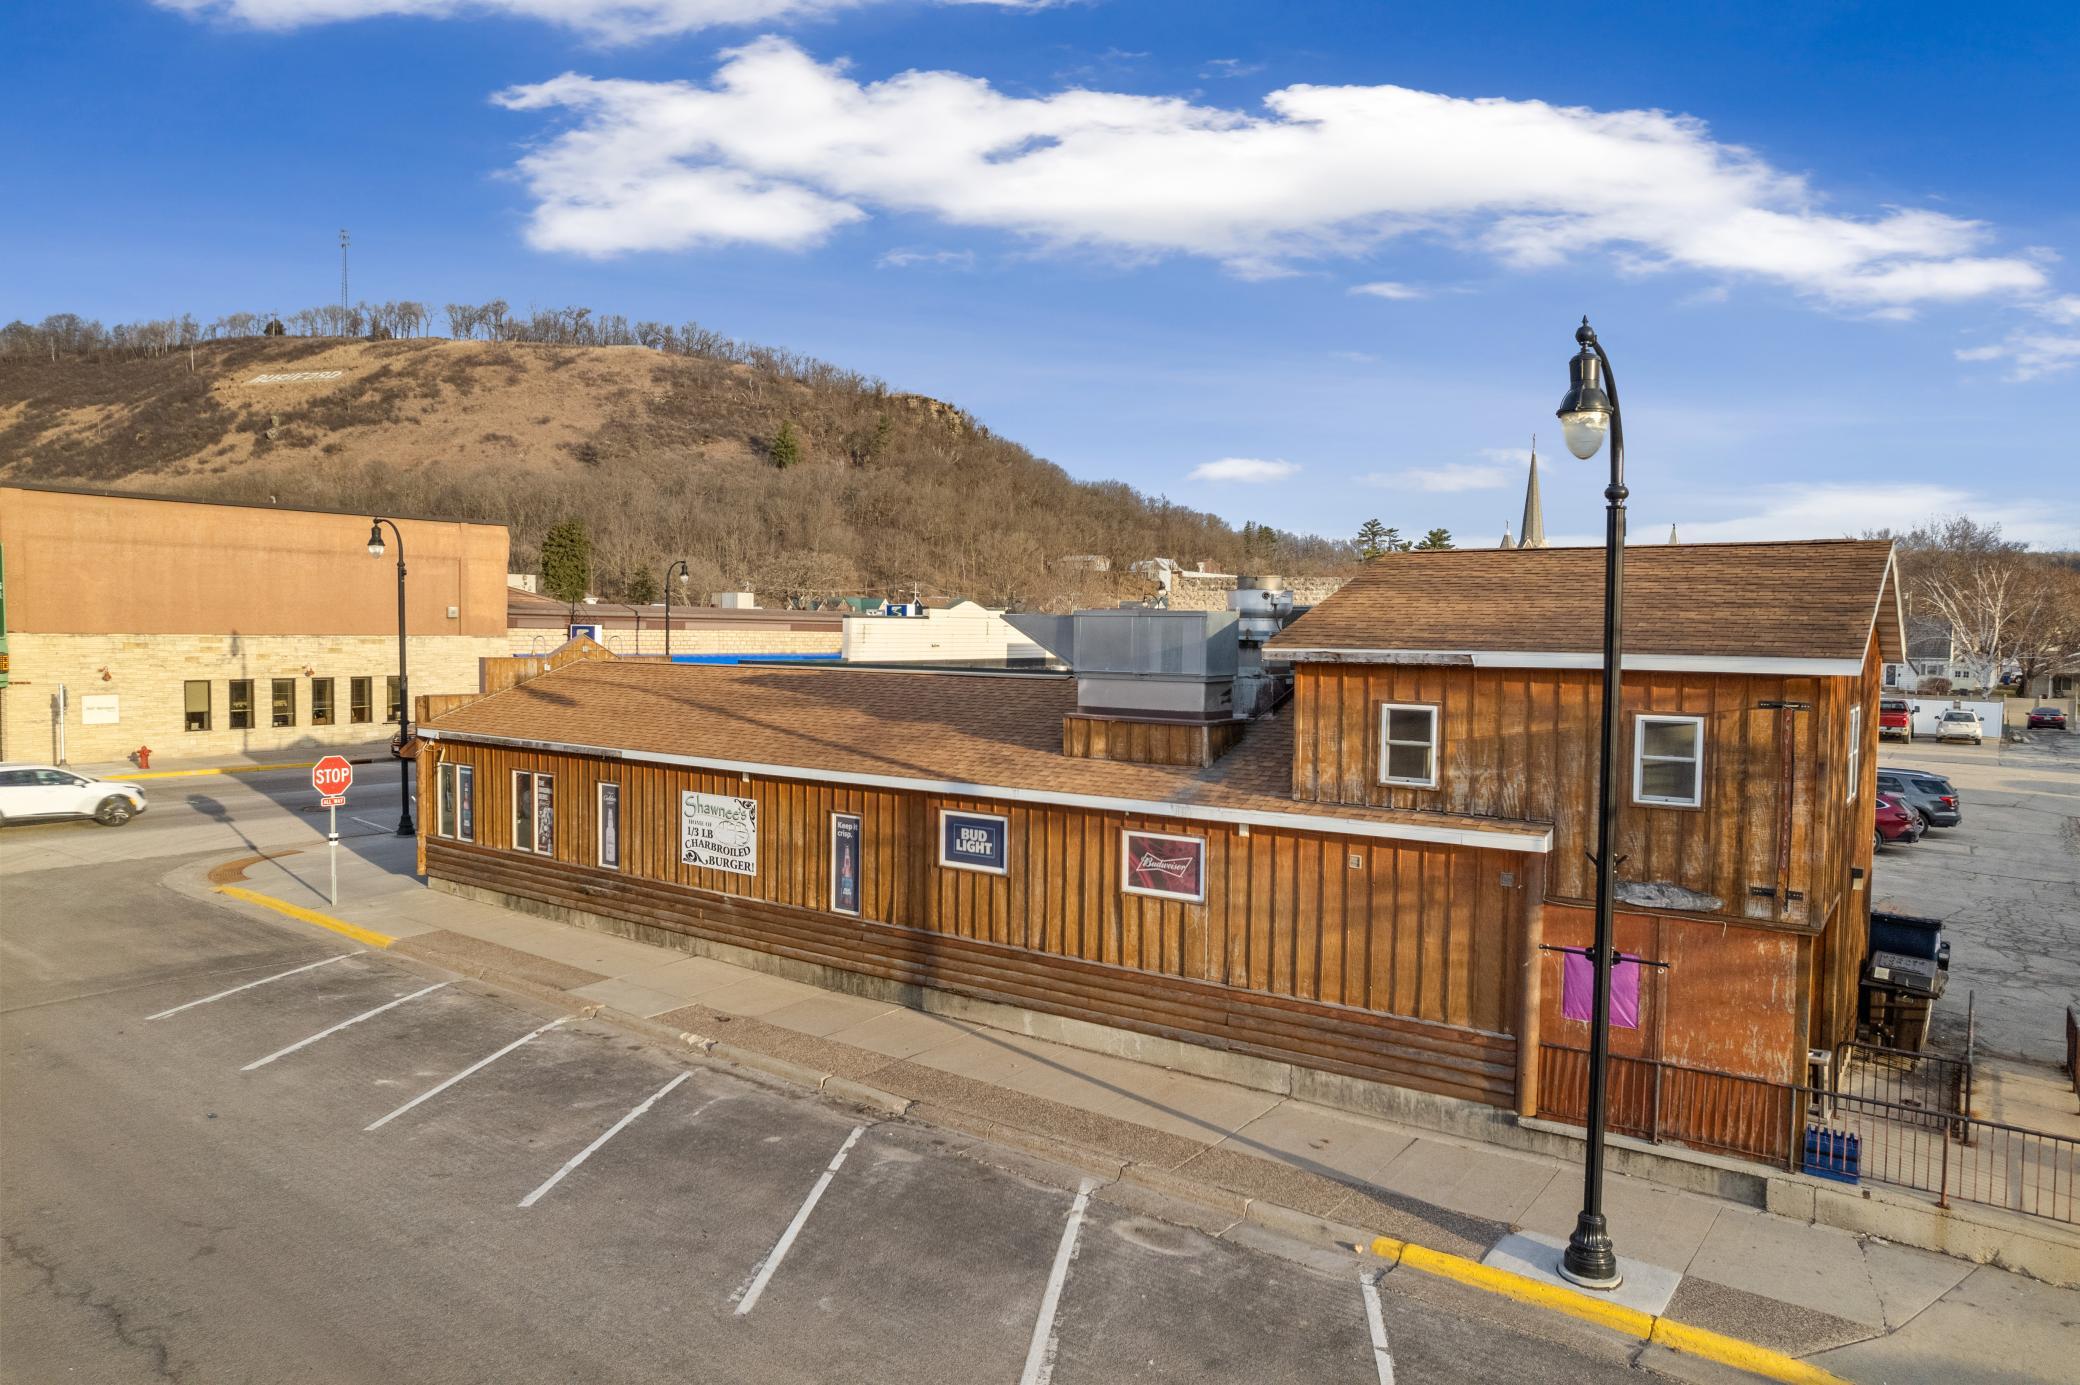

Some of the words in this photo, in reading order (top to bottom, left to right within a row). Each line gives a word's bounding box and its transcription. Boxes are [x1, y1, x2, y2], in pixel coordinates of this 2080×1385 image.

[316, 768, 350, 784] STOP
[684, 794, 747, 821] Shawnee's
[688, 818, 703, 826] HOME
[837, 821, 853, 832] Keep
[853, 823, 859, 831] it
[687, 826, 699, 837] 1/3
[702, 828, 714, 839] LB
[837, 830, 853, 839] crisp.
[961, 827, 988, 842] BUD
[684, 838, 751, 857] CHARBROILED
[955, 839, 993, 855] LIGHT
[708, 856, 754, 873] BURGER!
[1141, 855, 1187, 871] Budweiser
